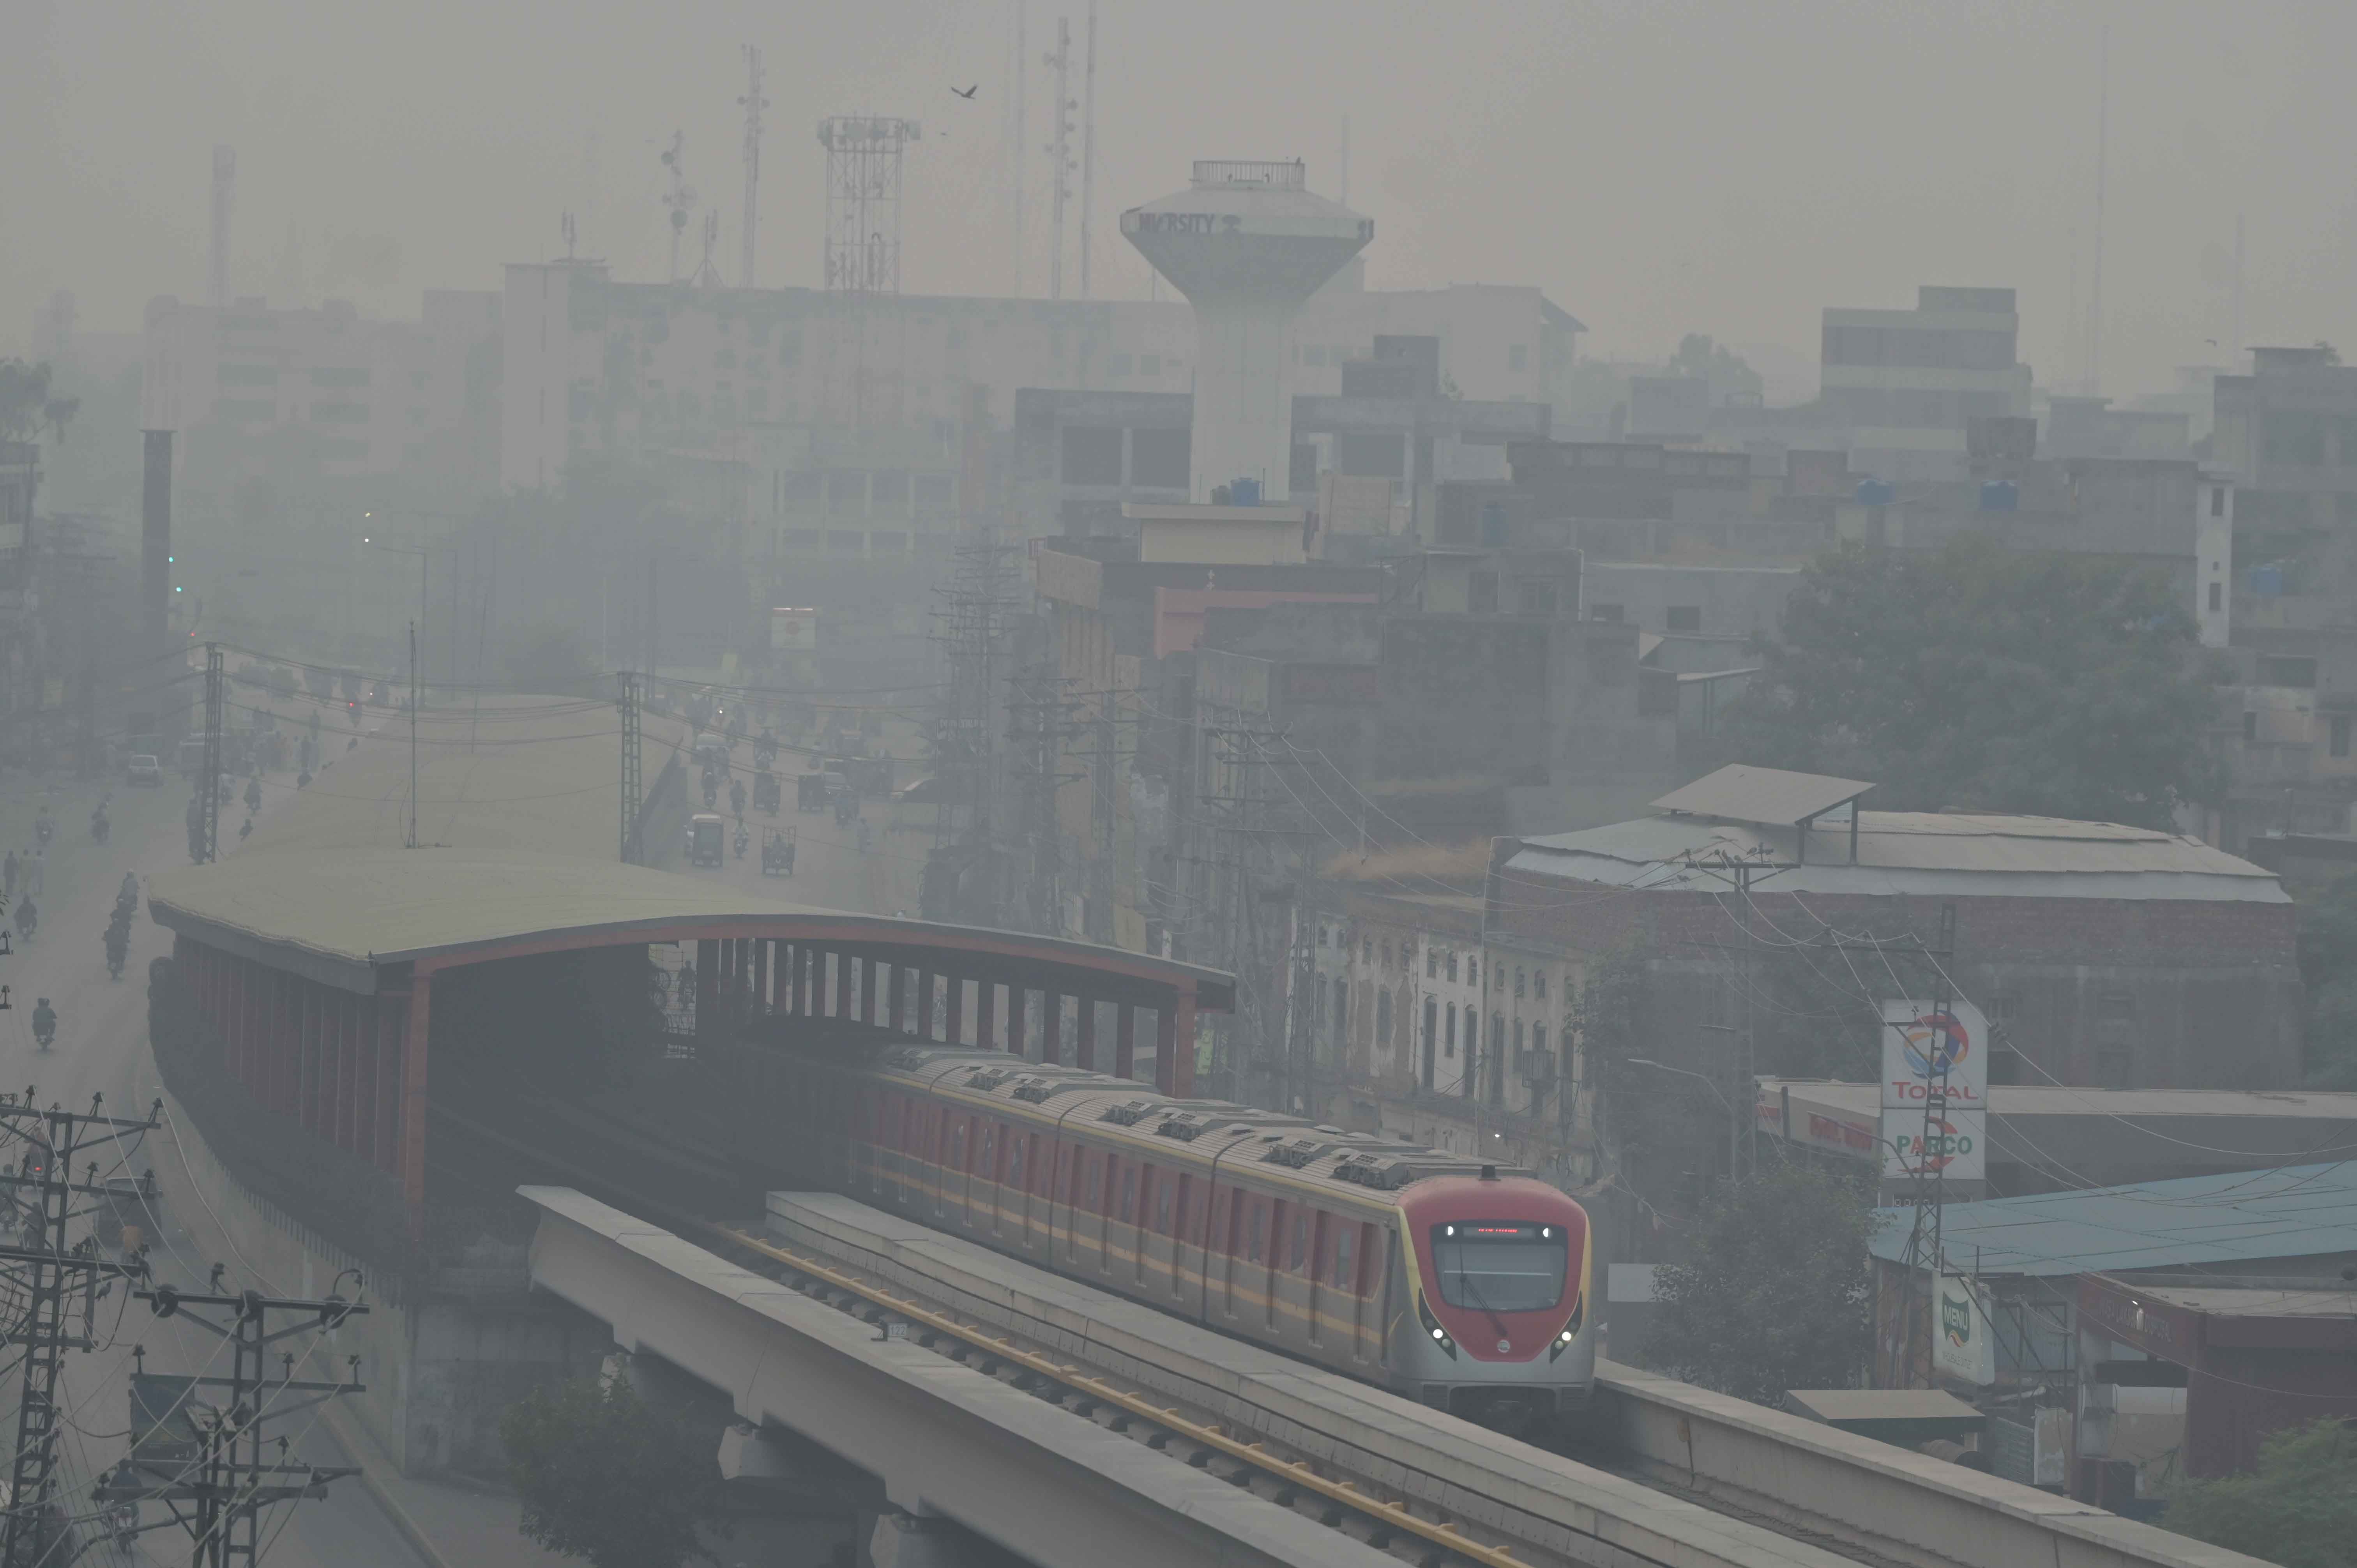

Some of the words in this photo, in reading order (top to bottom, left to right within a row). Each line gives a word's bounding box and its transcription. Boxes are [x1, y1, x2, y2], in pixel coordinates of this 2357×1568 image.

[1892, 1082, 1978, 1099] TOTAL
[1897, 1136, 1972, 1154] PARCO
[1944, 1304, 1968, 1331] MENU
